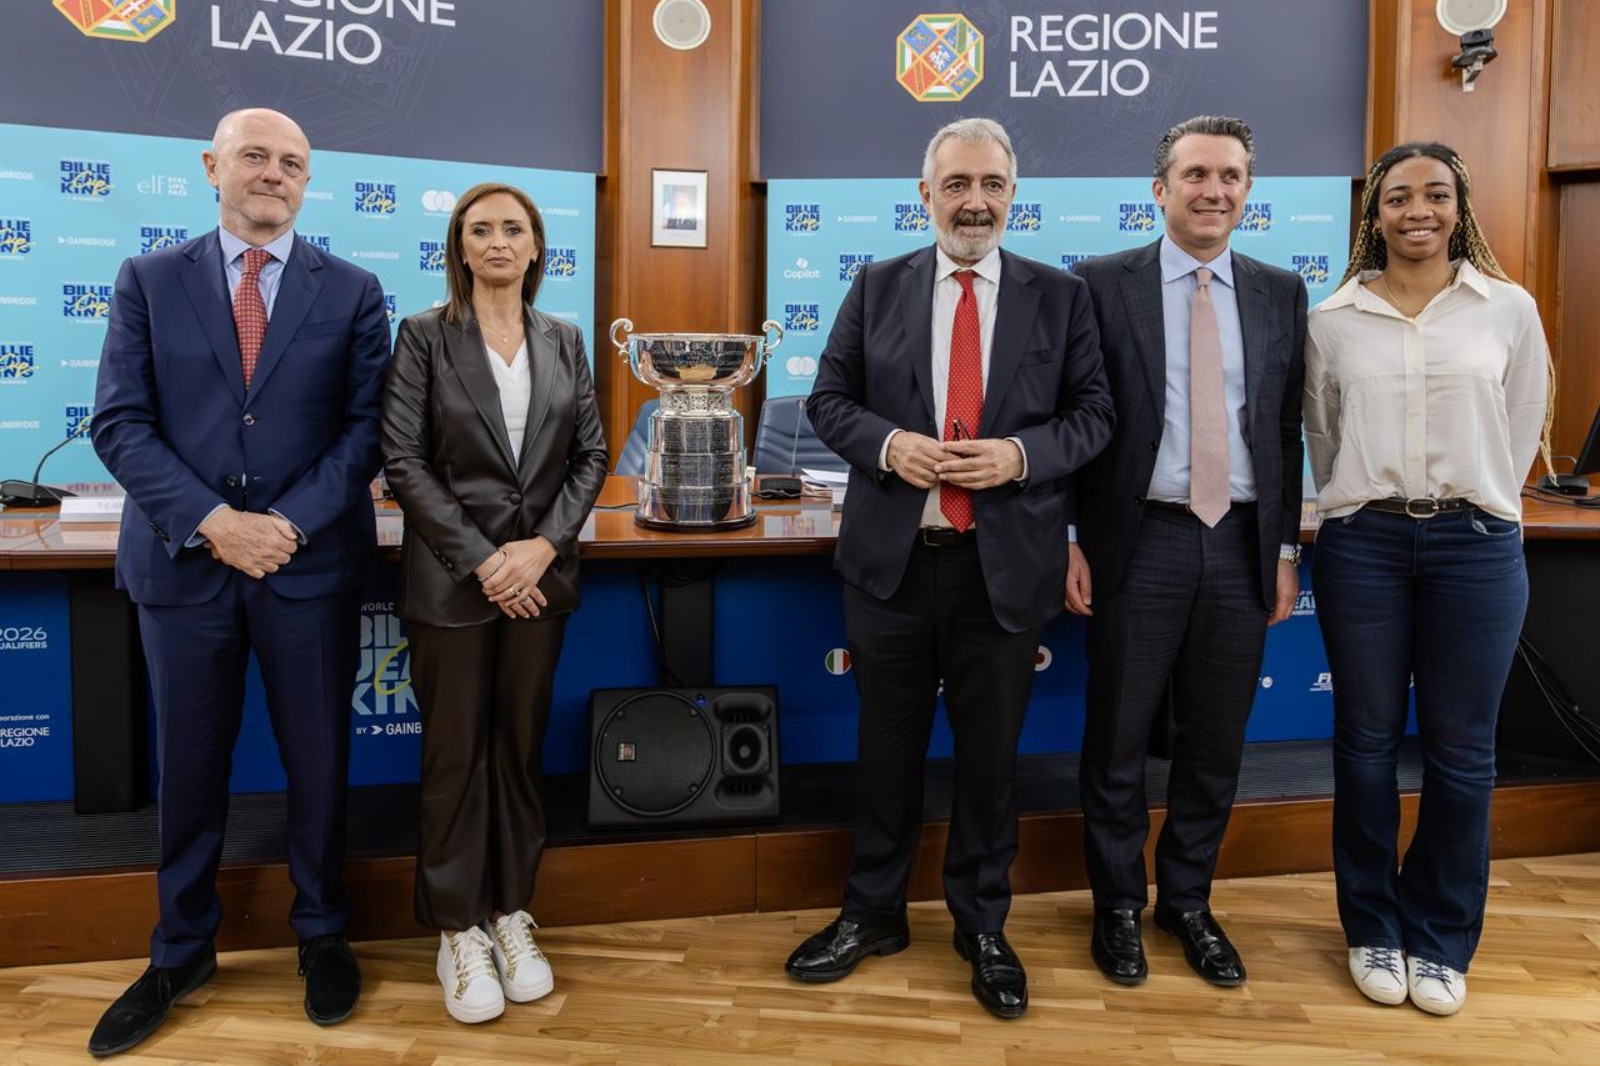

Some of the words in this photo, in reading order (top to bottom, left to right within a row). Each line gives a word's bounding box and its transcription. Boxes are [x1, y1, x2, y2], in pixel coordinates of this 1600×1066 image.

[211, 4, 382, 65] LAZIO
[1010, 11, 1218, 52] REGIONE
[1009, 58, 1150, 98] LAZIO
[60, 160, 110, 174] BILLIE
[355, 182, 396, 194] BILLIE
[786, 204, 820, 214] BILLIE
[1120, 203, 1155, 213] BILLIE
[141, 226, 188, 239] BILLIE
[1292, 255, 1329, 265] BILLIE
[784, 268, 820, 280] Copilot
[63, 284, 112, 297] BILLIE
[785, 304, 820, 313] BILLIE
[0, 727, 51, 738] REGIONE
[0, 737, 35, 748] LAZIO
